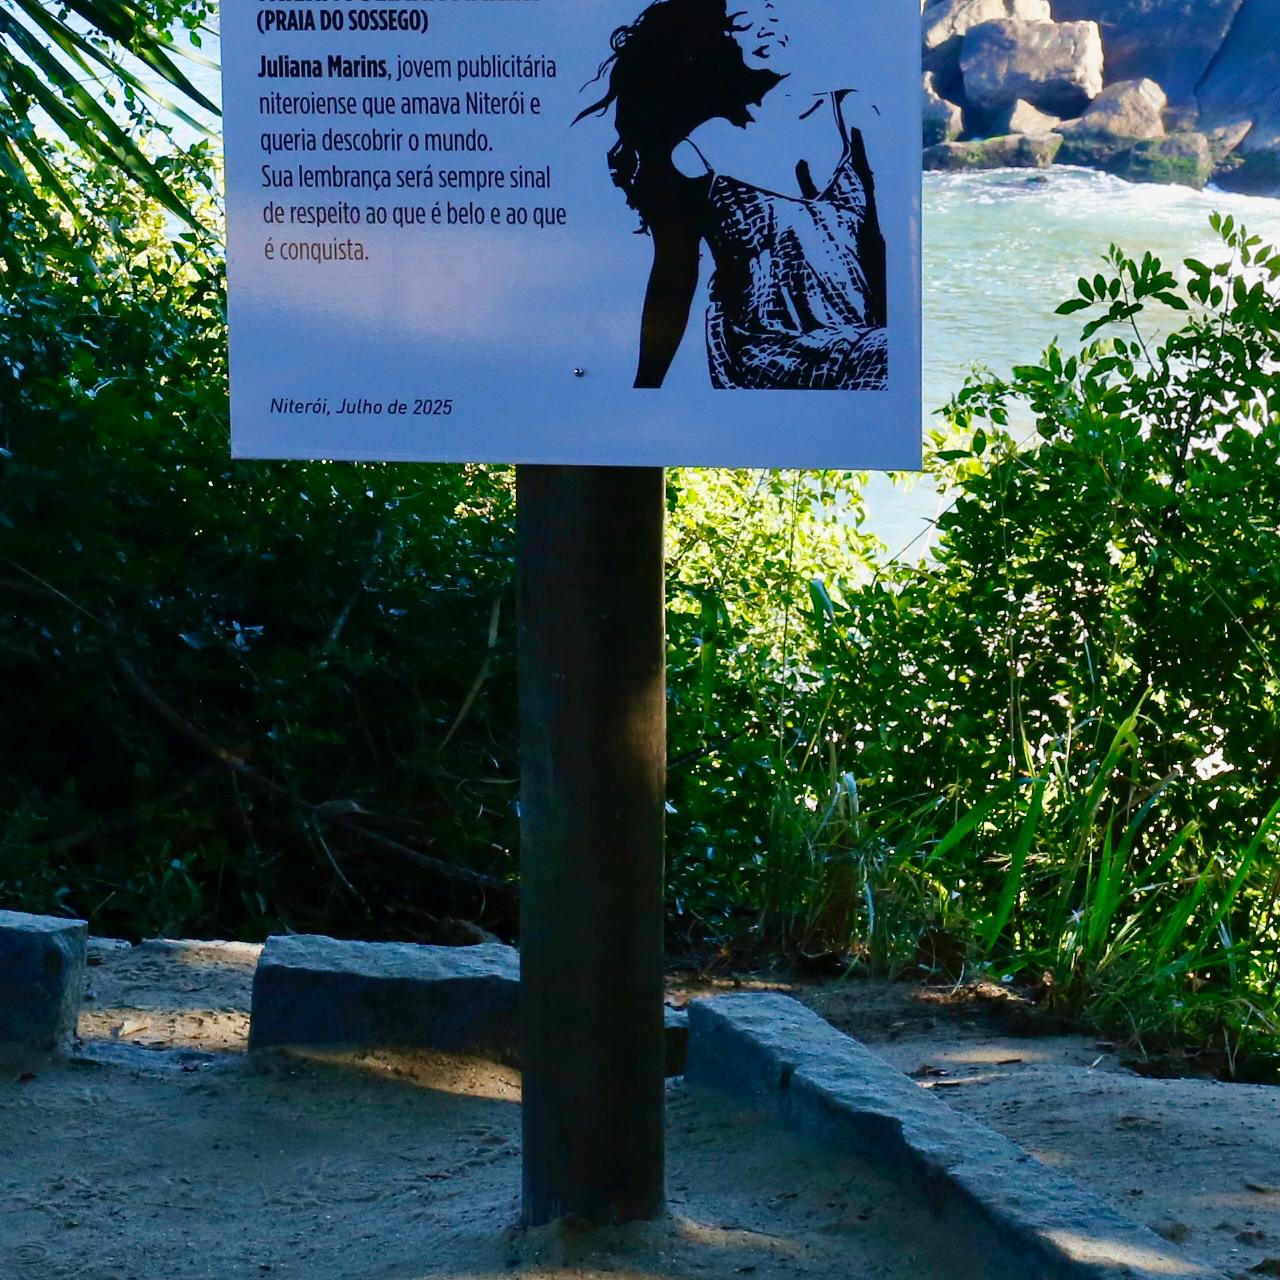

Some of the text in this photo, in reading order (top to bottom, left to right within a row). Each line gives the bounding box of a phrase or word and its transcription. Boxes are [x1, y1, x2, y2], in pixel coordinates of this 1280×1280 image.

[256, 9, 429, 35] (PRAIA DO SOSSEGO)
[257, 54, 557, 82] Juliana Marins, jovem publicitária
[259, 90, 541, 119] niteroiense que amava Niterói e
[260, 127, 493, 155] queria descobrir o mundo.
[261, 164, 551, 192] Sua lembrança será sempre sinal
[263, 200, 567, 229] de respeito ao que é belo e ao que
[264, 236, 369, 264] é conquista.
[270, 397, 453, 416] Niterói, Julho de 2025
